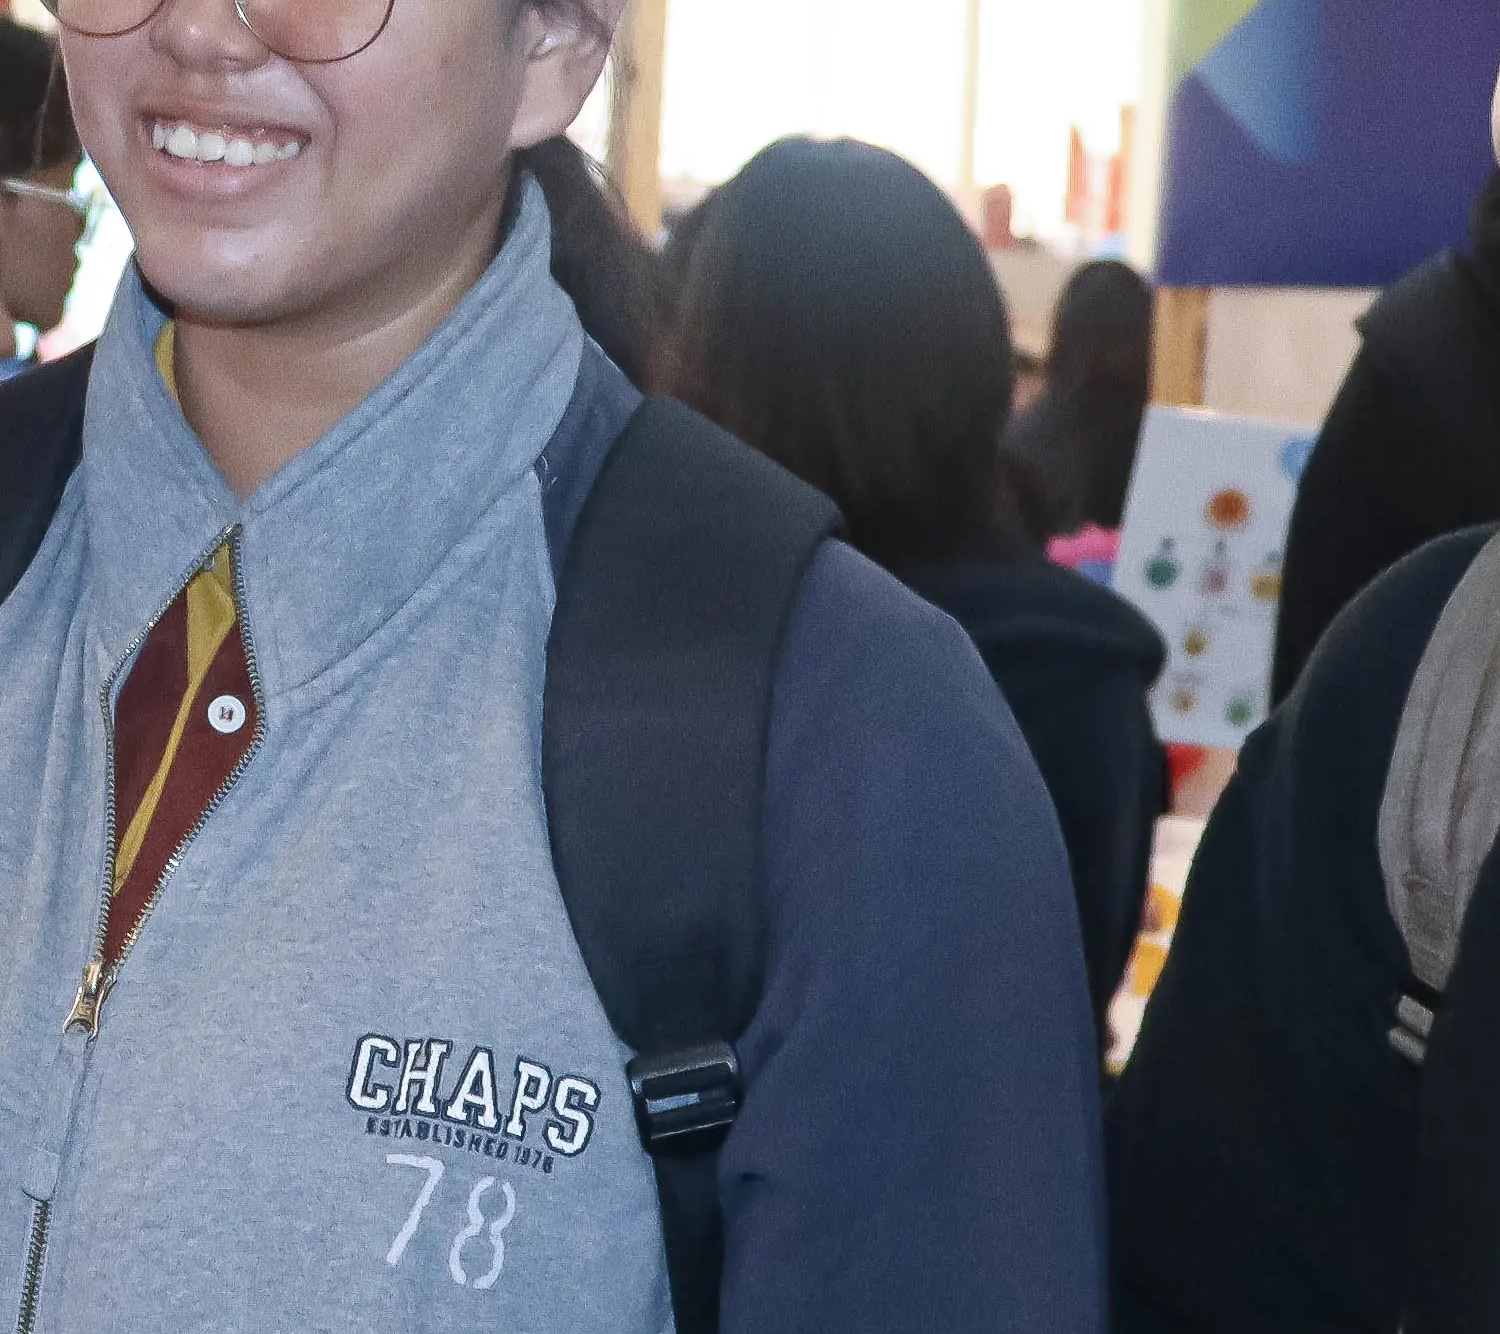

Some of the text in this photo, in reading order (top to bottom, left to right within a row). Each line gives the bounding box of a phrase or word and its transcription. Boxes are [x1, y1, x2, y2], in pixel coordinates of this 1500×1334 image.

[346, 1032, 601, 1157] CHAPS
[365, 1115, 509, 1160] ESTABLISHED
[385, 1153, 517, 1290] 78
